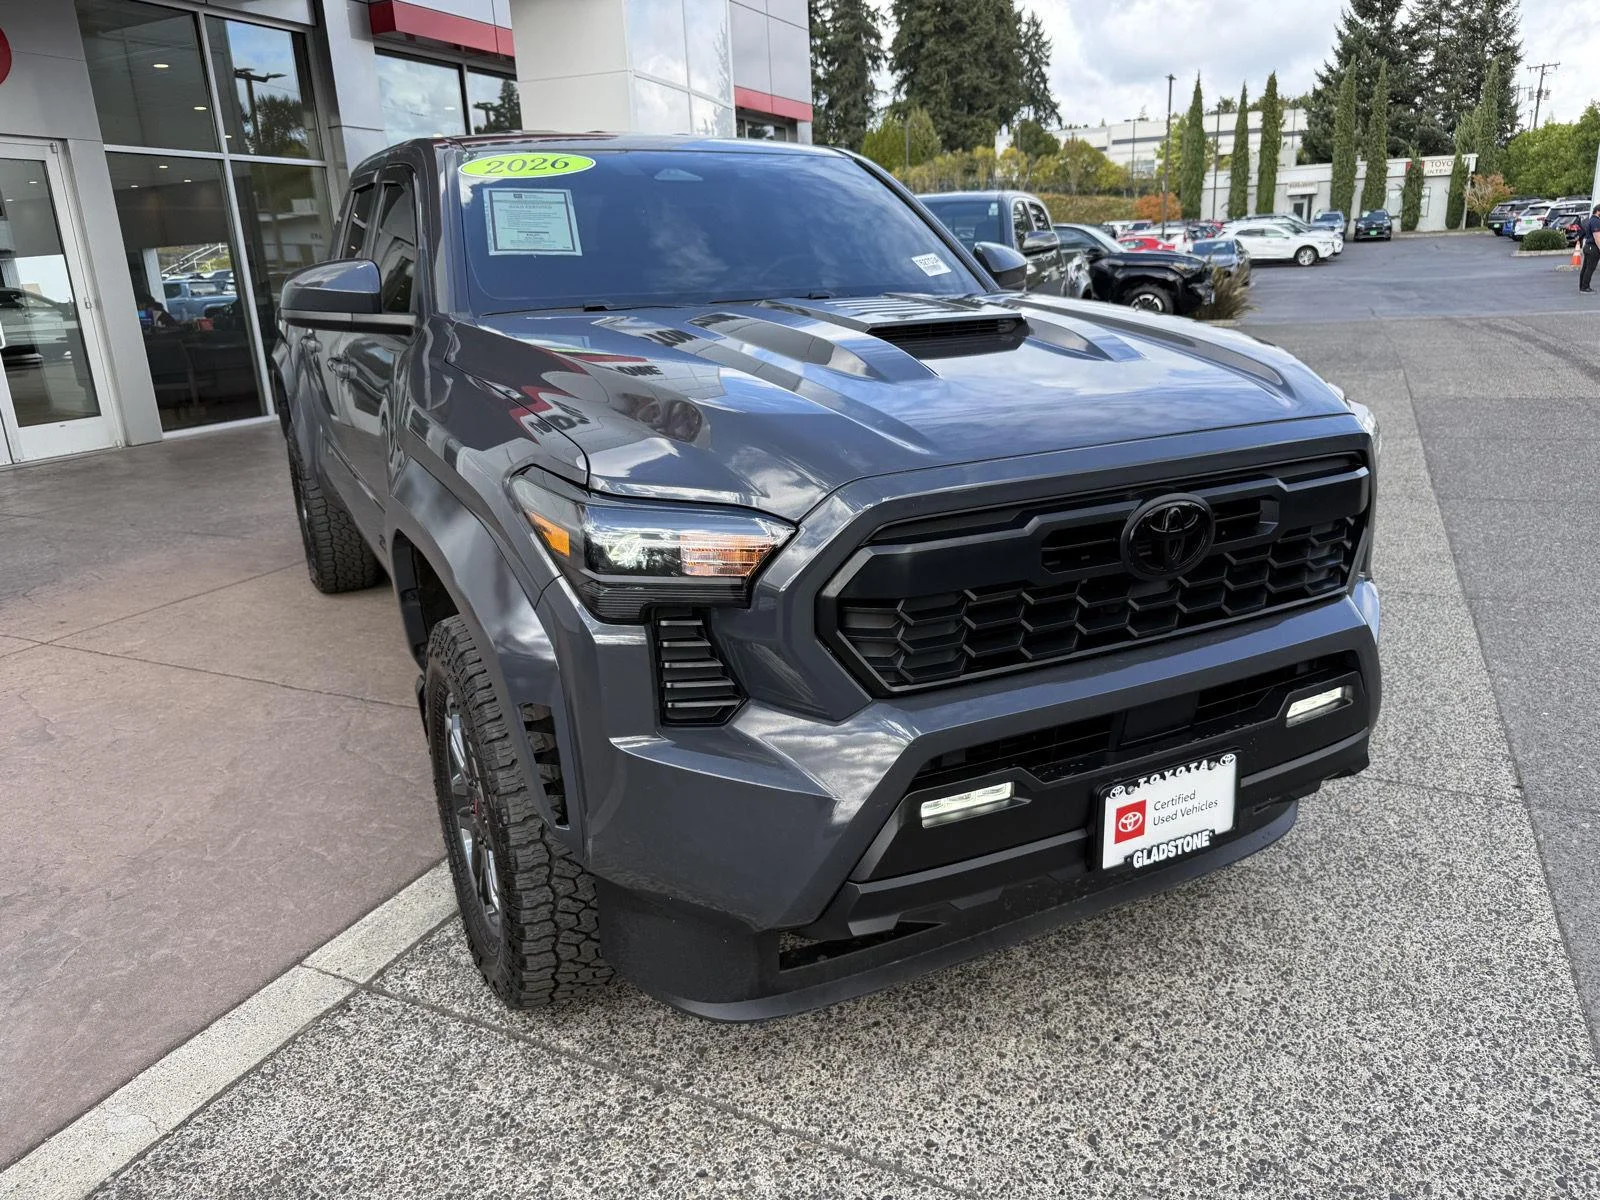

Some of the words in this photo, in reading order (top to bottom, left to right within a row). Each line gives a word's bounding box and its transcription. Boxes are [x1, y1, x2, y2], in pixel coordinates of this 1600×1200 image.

[484, 157, 570, 174] 2026
[1137, 760, 1208, 788] TOYOTA
[1153, 789, 1196, 811] Certified
[1153, 811, 1178, 826] Used
[1180, 799, 1218, 817] Vehicles
[1133, 831, 1210, 868] GLADSTONE
